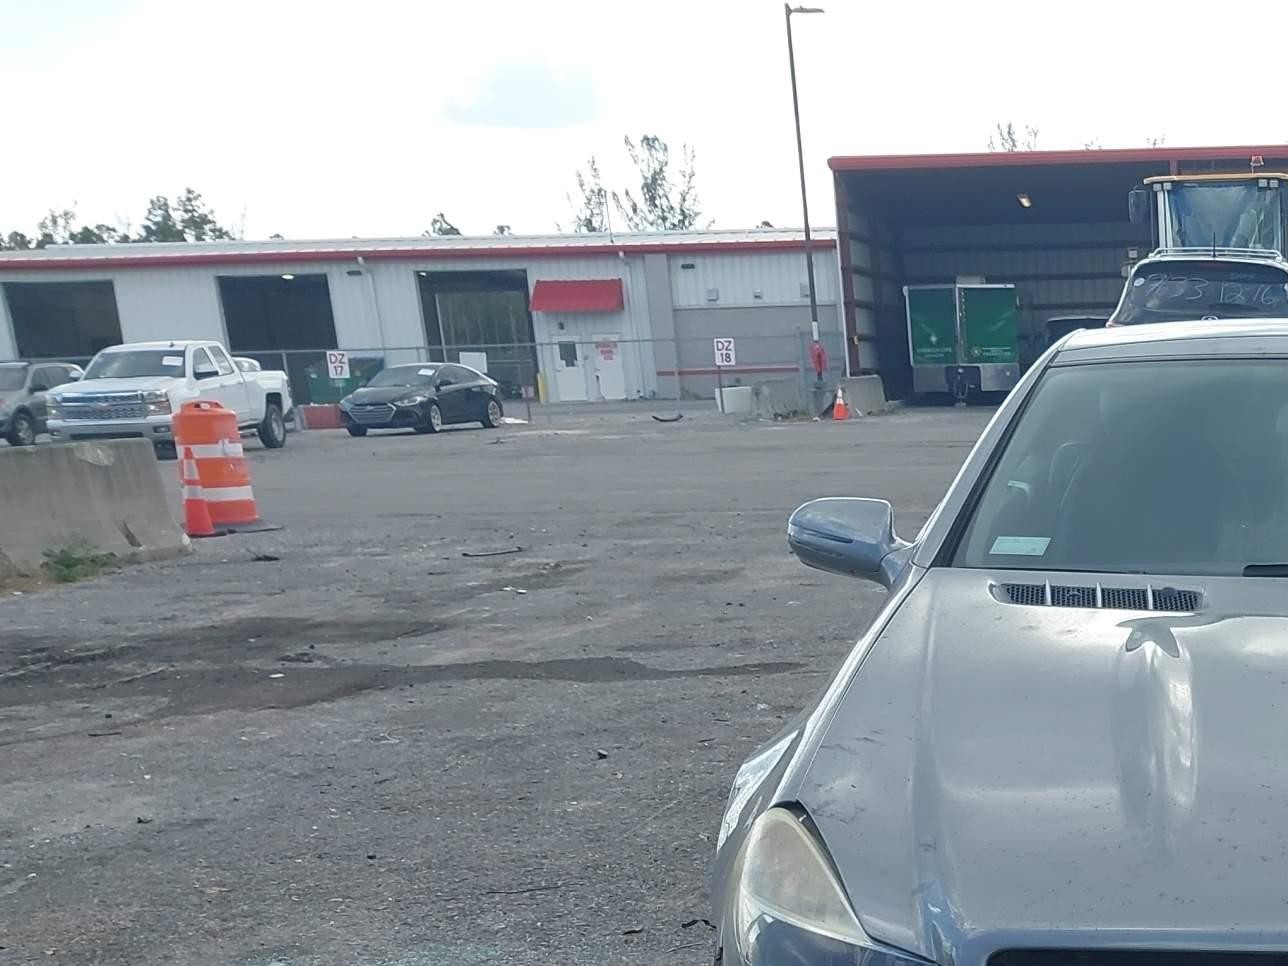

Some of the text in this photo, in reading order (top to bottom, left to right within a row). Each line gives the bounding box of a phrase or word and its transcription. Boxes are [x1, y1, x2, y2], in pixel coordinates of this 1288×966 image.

[716, 340, 732, 351] DZ
[329, 353, 346, 364] DZ
[720, 352, 731, 363] 18
[333, 365, 344, 376] 17
